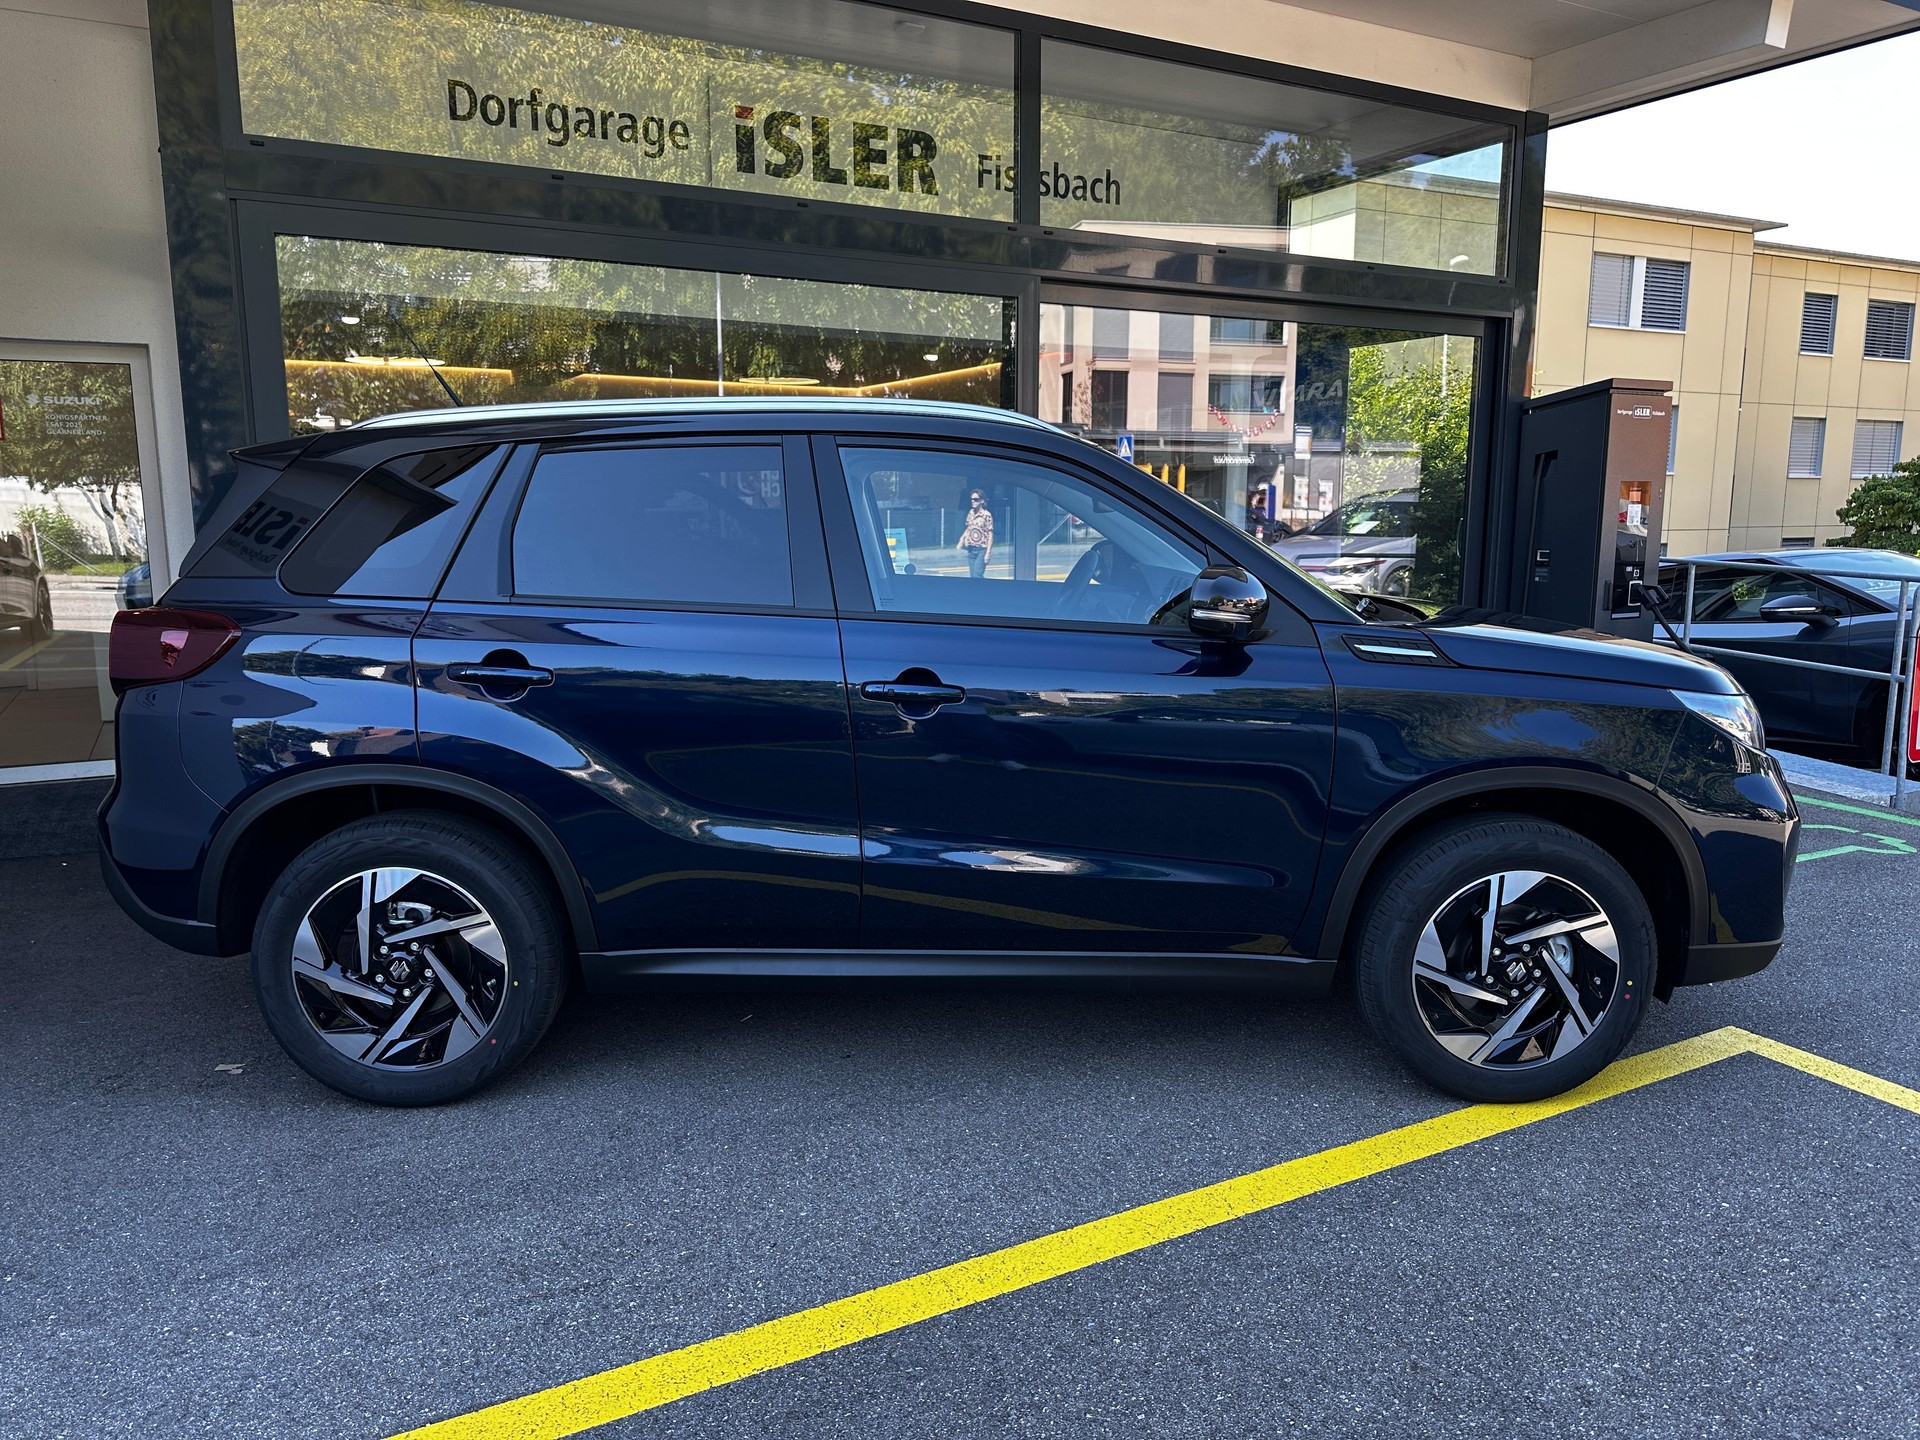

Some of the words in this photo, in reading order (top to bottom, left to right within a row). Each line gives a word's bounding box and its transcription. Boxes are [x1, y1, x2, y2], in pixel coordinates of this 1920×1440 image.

[447, 78, 690, 159] Dorfgarage
[977, 153, 1121, 205] Fissbach
[43, 396, 100, 405] SUZUKI
